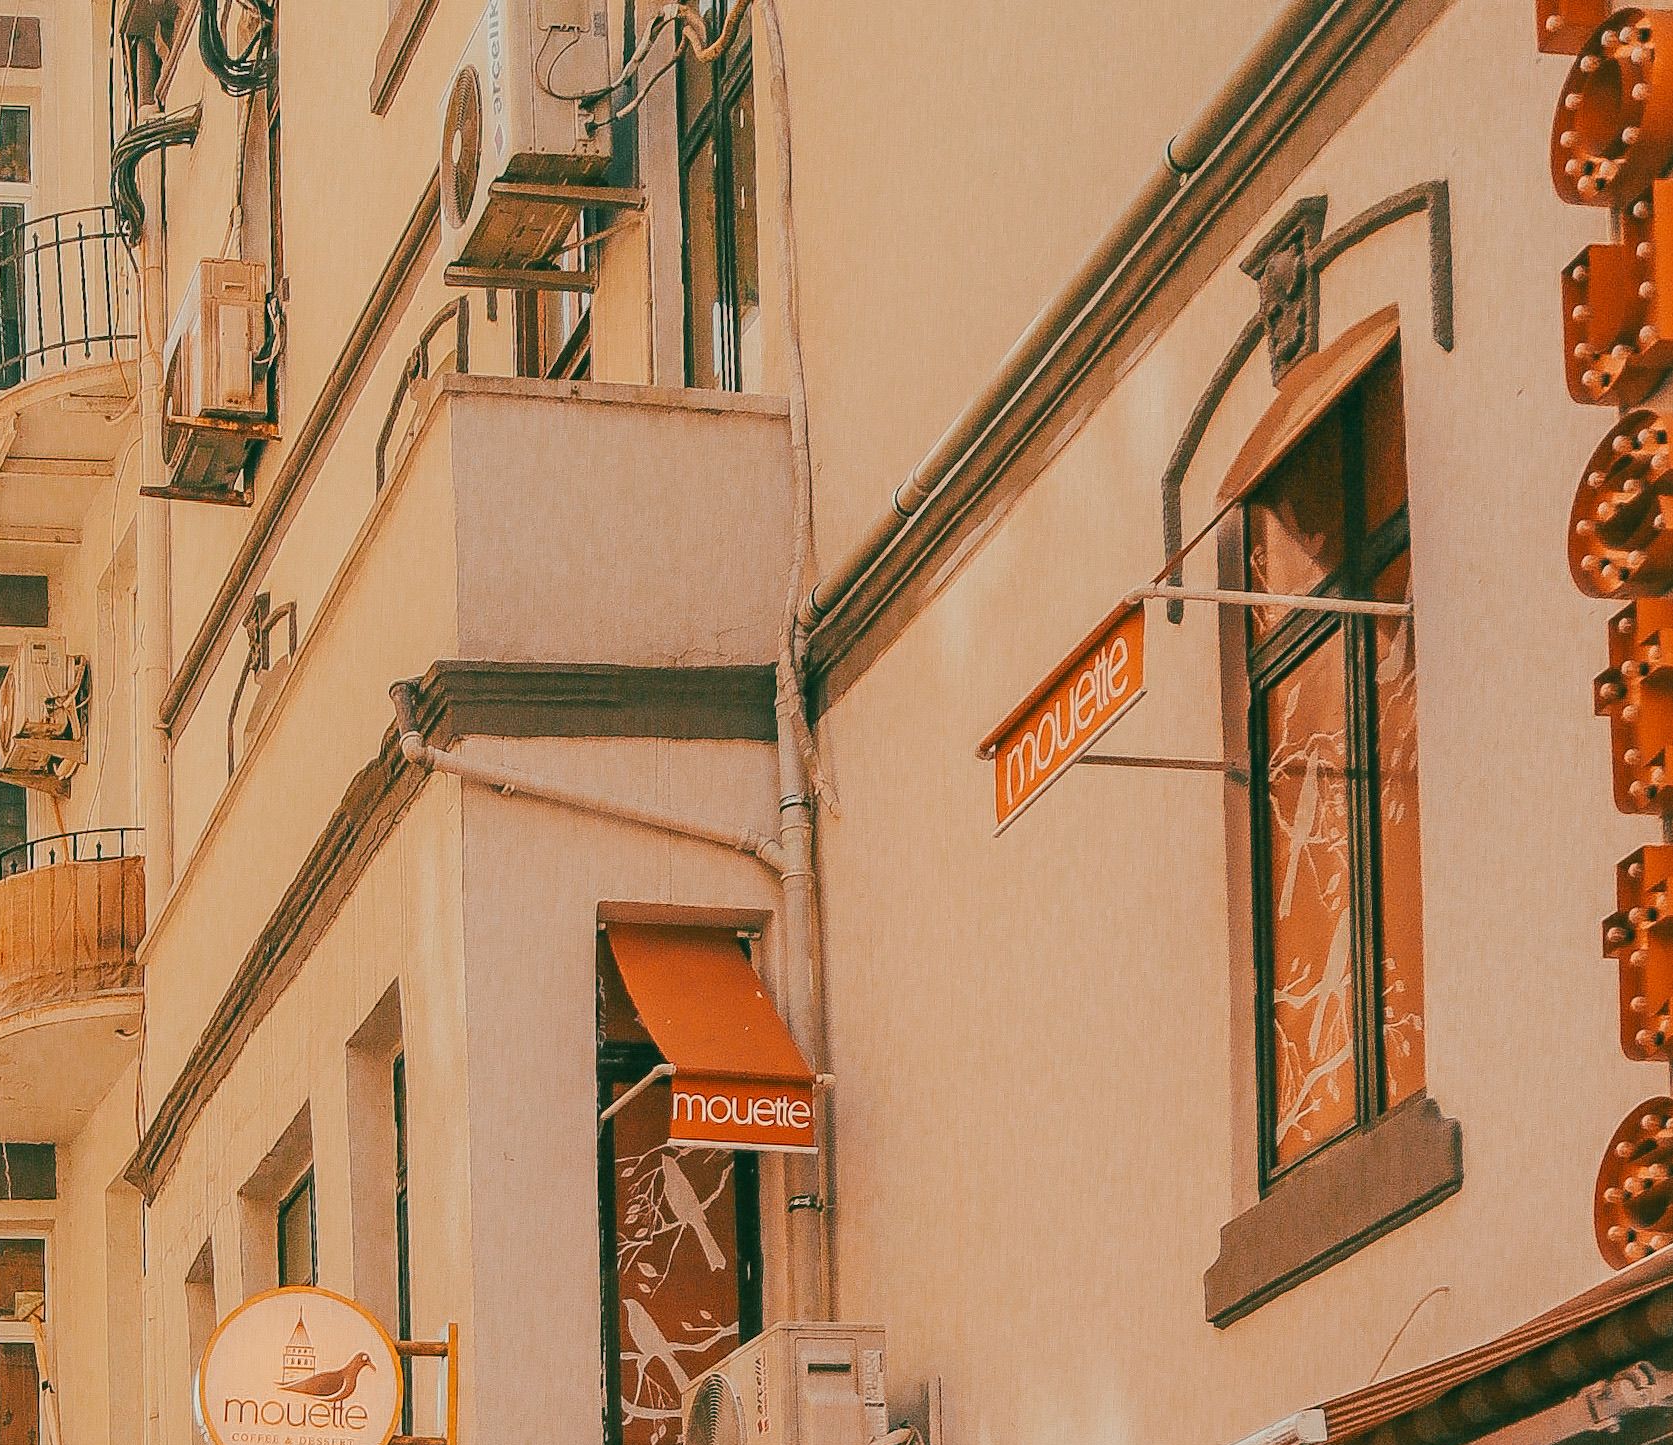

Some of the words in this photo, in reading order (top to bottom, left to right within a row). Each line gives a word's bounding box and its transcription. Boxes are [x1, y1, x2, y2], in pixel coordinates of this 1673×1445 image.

[1006, 636, 1129, 806] mouette
[672, 1091, 811, 1129] mouette
[224, 1398, 368, 1430] mouette
[231, 1432, 279, 1444] COFFEE
